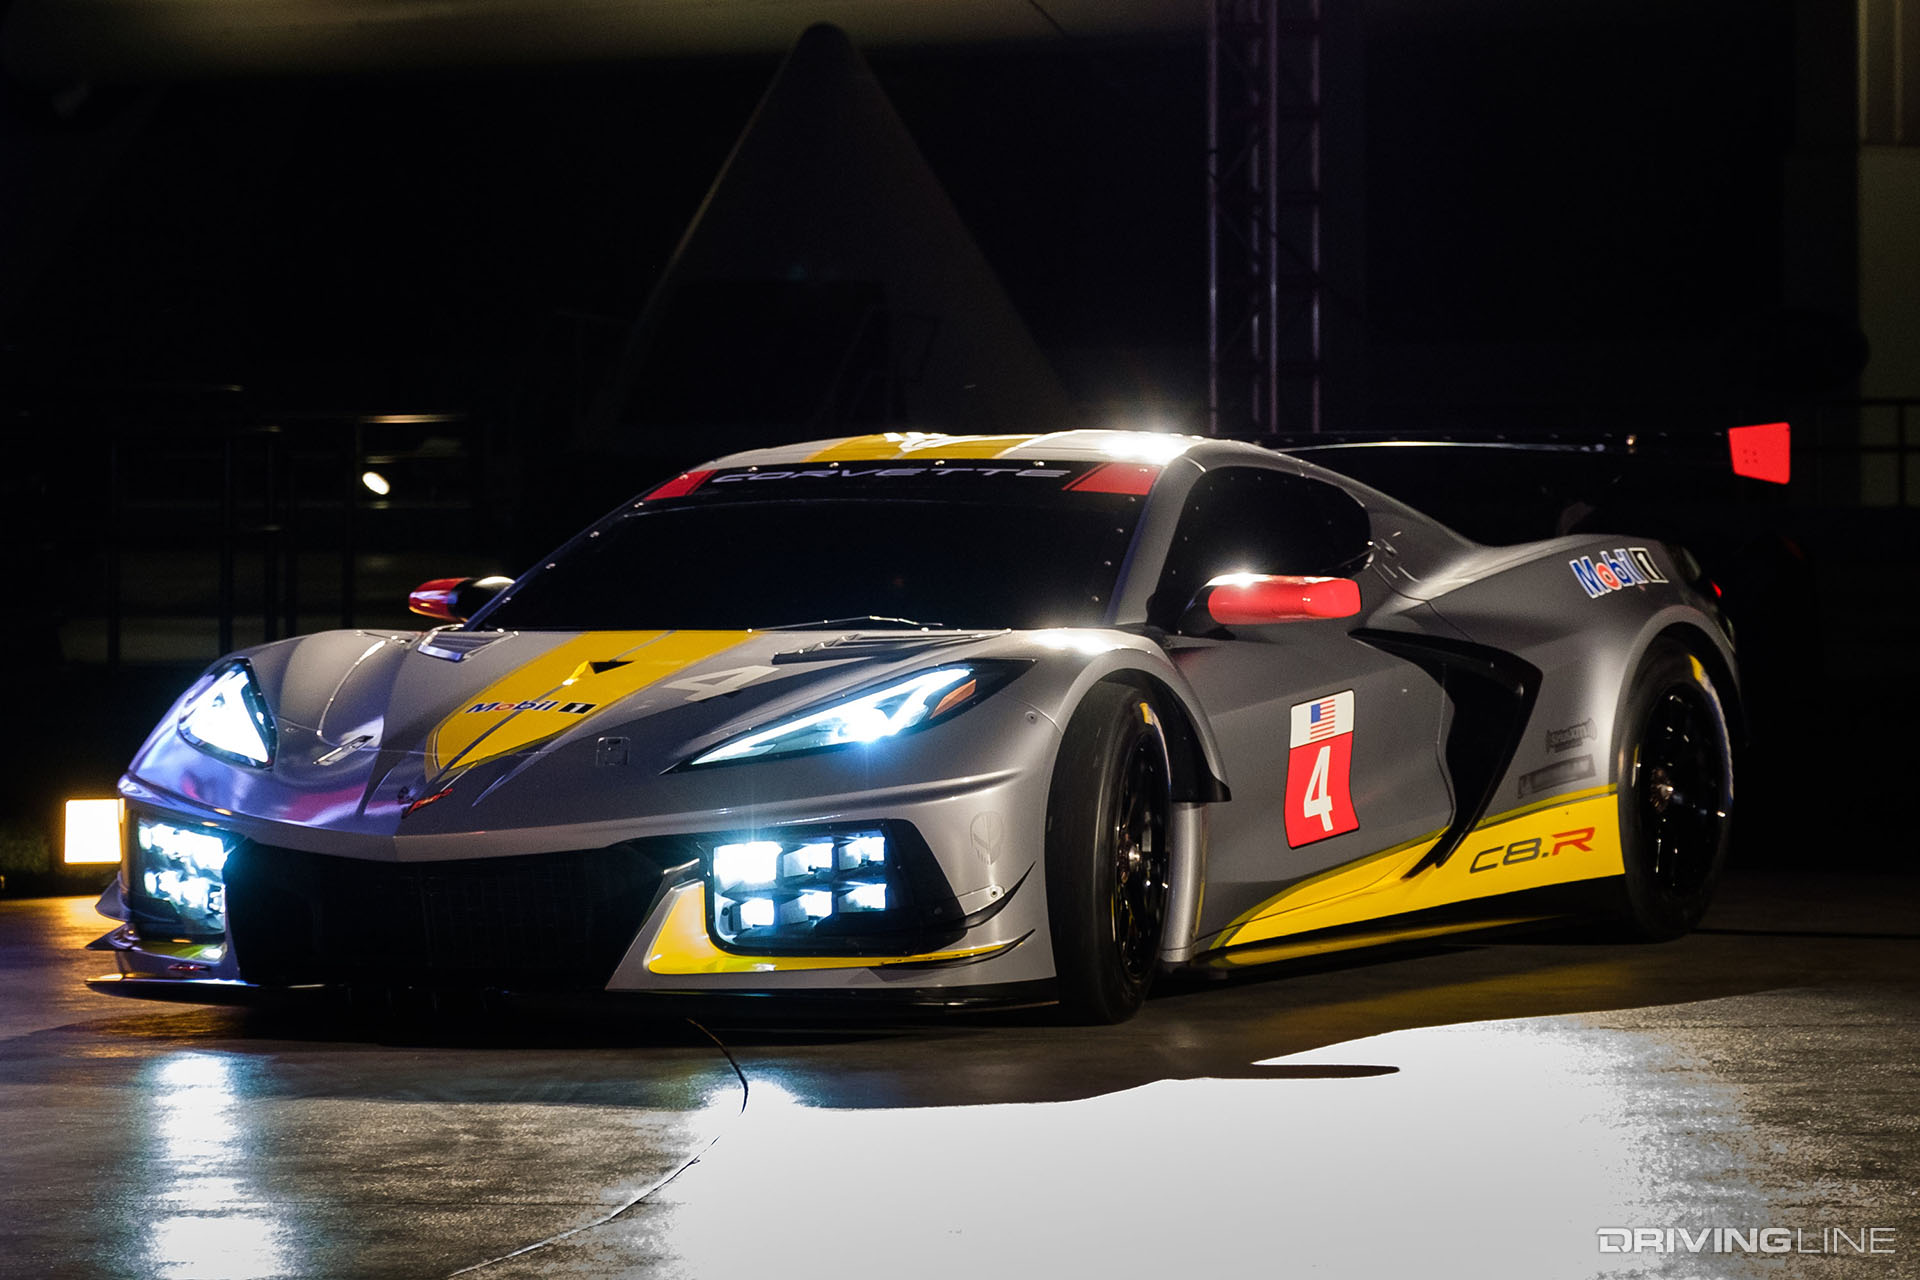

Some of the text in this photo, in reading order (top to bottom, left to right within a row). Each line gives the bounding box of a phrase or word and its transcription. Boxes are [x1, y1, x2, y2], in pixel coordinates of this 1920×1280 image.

[711, 467, 1072, 482] CORVETTE
[1569, 549, 1649, 599] Mobil
[660, 665, 780, 702] 4
[465, 700, 560, 714] Mobil
[1303, 745, 1335, 832] 4
[1469, 827, 1596, 874] C8.R
